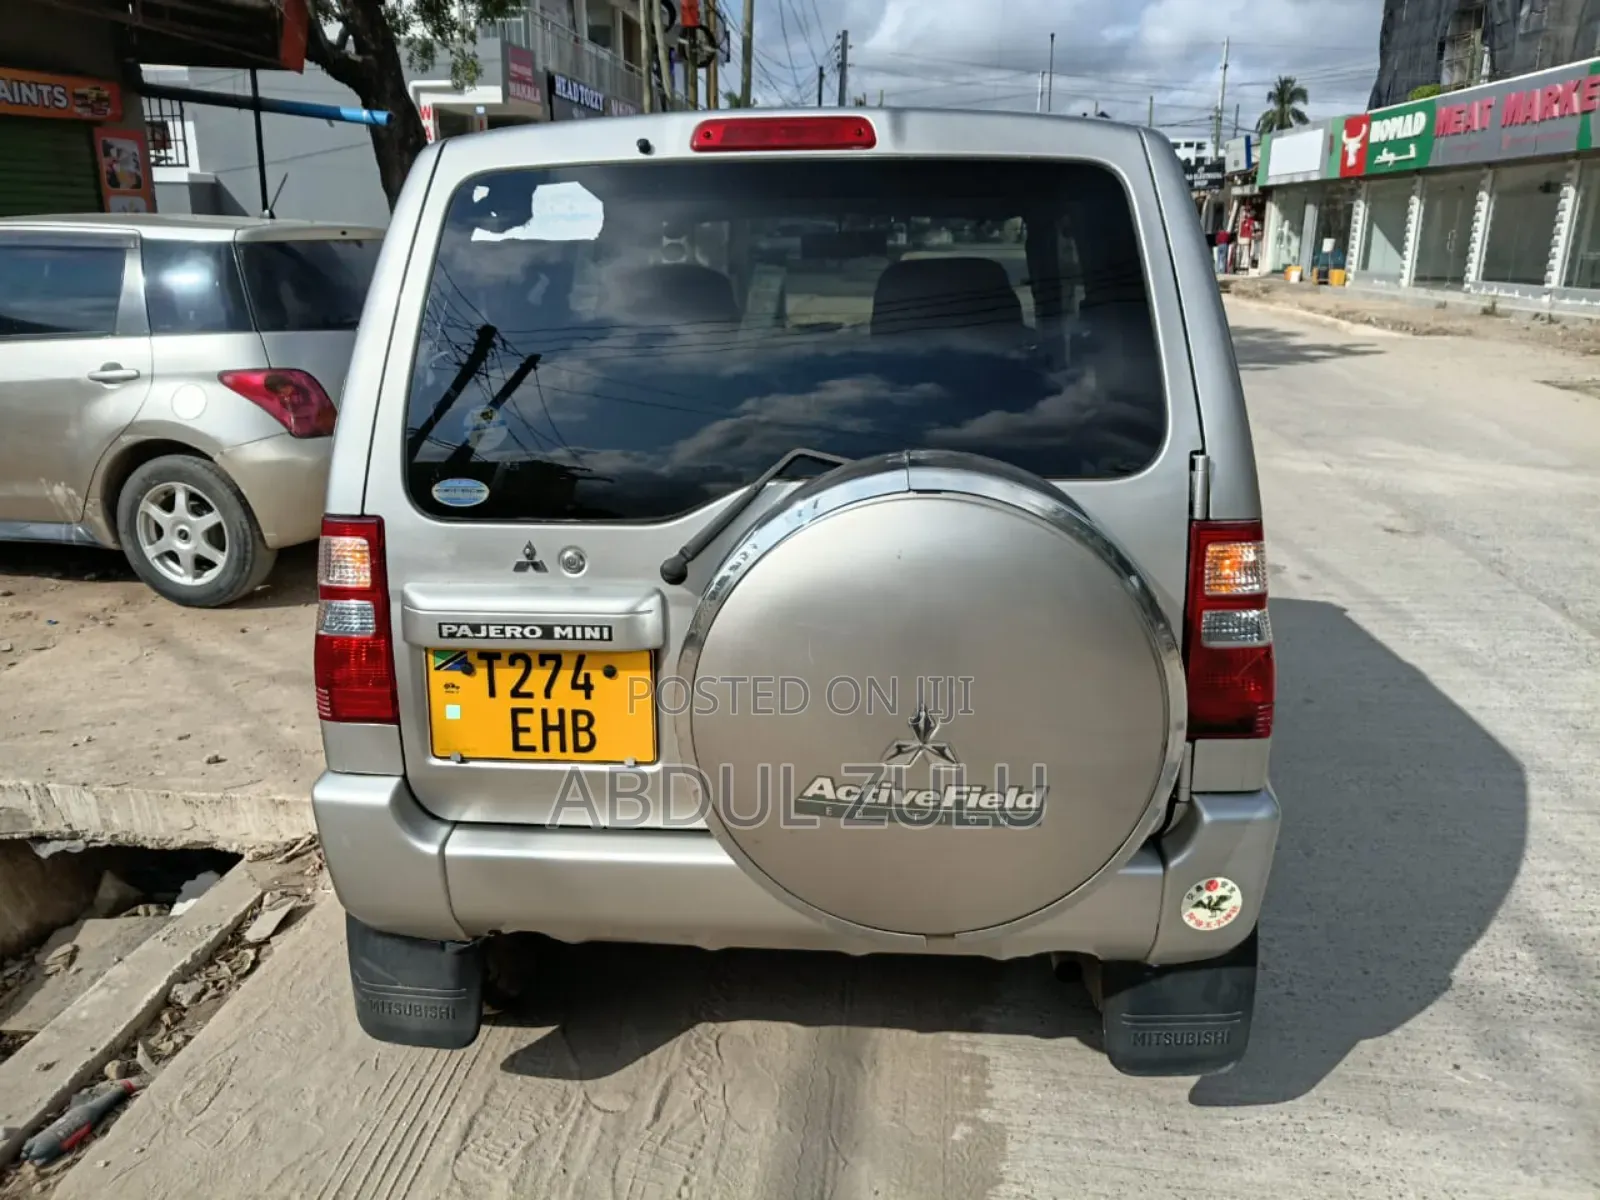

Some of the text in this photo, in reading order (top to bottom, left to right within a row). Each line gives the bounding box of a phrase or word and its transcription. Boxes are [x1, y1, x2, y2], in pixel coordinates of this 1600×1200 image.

[1369, 75, 1600, 143] NOMAD MEAT MARKE
[440, 624, 611, 640] PAJERO MINI
[477, 652, 595, 700] T274
[510, 707, 597, 753] EHB
[803, 776, 1049, 810] ActiveField
[369, 999, 456, 1020] MITSUBISHI
[1132, 1030, 1230, 1047] MITSUBISHI
